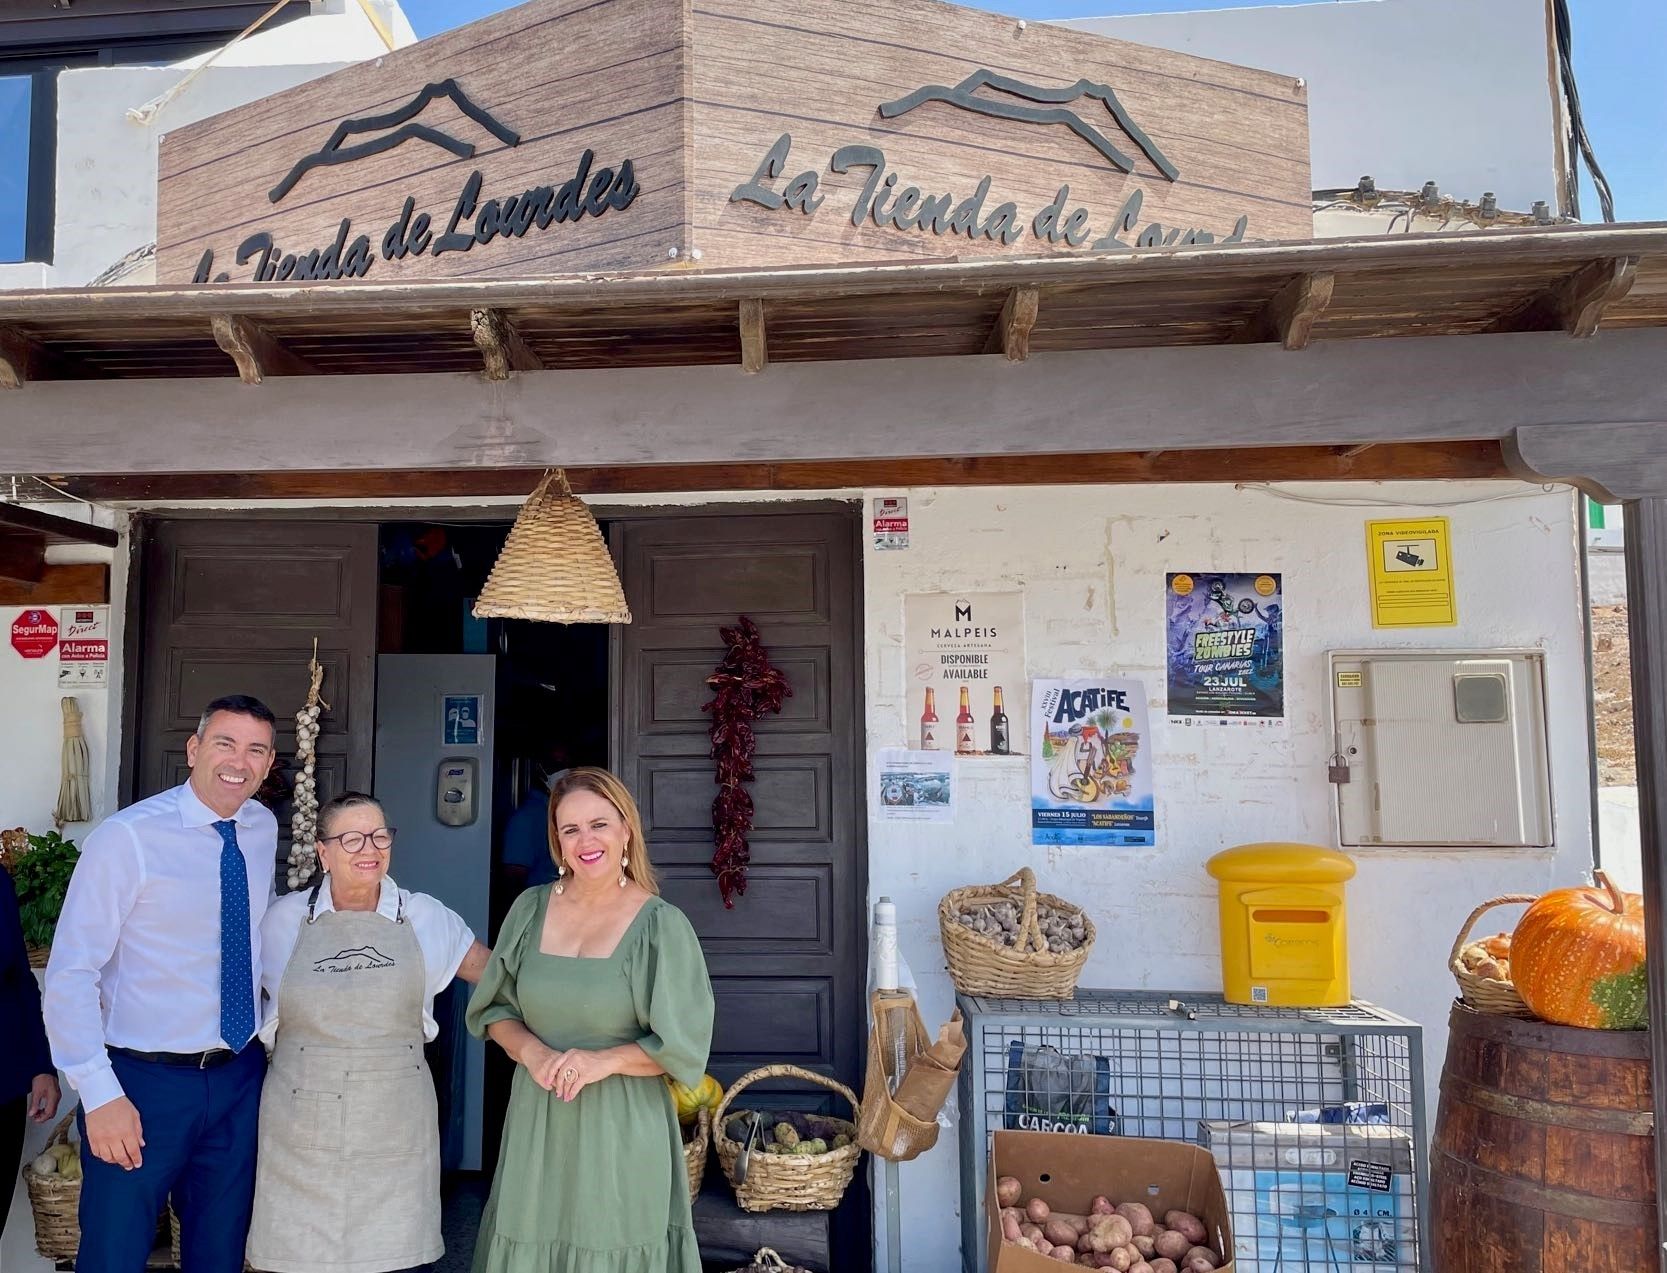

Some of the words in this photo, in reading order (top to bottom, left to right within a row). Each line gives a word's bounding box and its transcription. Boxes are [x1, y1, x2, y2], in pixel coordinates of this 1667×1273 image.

[730, 133, 825, 214] La
[832, 145, 1024, 244] Tienda
[1032, 184, 1090, 245] de
[235, 217, 375, 282] Tienda
[382, 196, 432, 261] de
[431, 149, 640, 257] Lourdes
[875, 519, 908, 528] Alarma
[12, 624, 57, 636] SegurMap
[68, 621, 102, 637] Direct
[931, 627, 998, 638] MALPEIS
[1195, 629, 1255, 647] FREESTYLE
[61, 642, 106, 653] Alarma
[1195, 644, 1251, 660] ZOMBIES
[941, 654, 989, 664] DISPONIBLE
[1194, 664, 1213, 673] TOUR
[1214, 660, 1253, 671] CANARIAS
[943, 668, 989, 679] AVAILABLE
[1203, 676, 1220, 686] 23
[1220, 677, 1247, 687] JUL
[1044, 688, 1060, 718] Festival
[313, 965, 325, 973] La
[328, 964, 352, 973] Tienda
[364, 960, 395, 969] Lourdes
